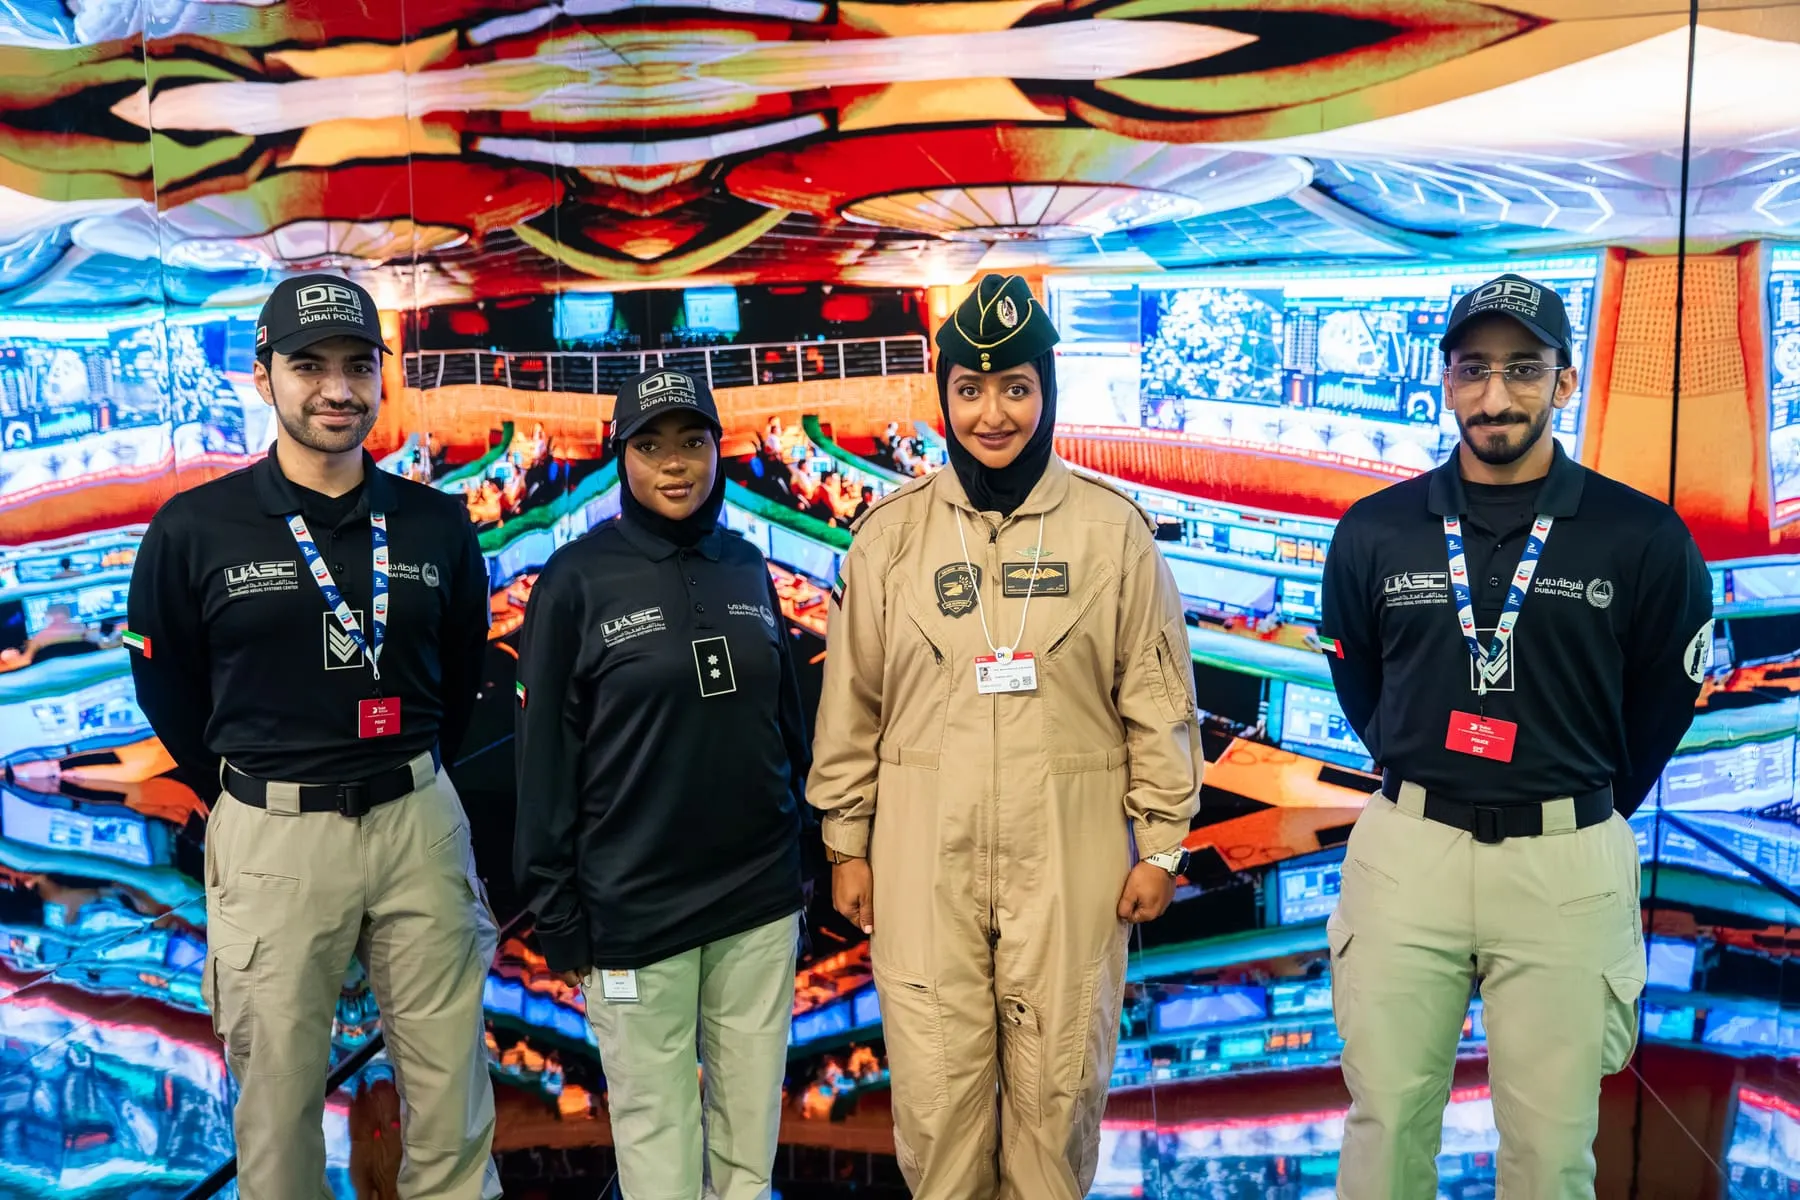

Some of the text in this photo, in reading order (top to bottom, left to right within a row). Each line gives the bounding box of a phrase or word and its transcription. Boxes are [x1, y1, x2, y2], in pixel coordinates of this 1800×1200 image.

[1500, 304, 1537, 317] POLICE
[300, 313, 365, 326] DUBAI POLICE
[640, 395, 698, 411] DUBAI POLICE
[226, 561, 295, 583] UASC
[397, 563, 420, 574] شرطة
[1384, 571, 1446, 594] UASC
[1535, 577, 1584, 591] شرطة دبي
[1534, 587, 1583, 599] DUBAI POLICE
[603, 608, 662, 635] UASC
